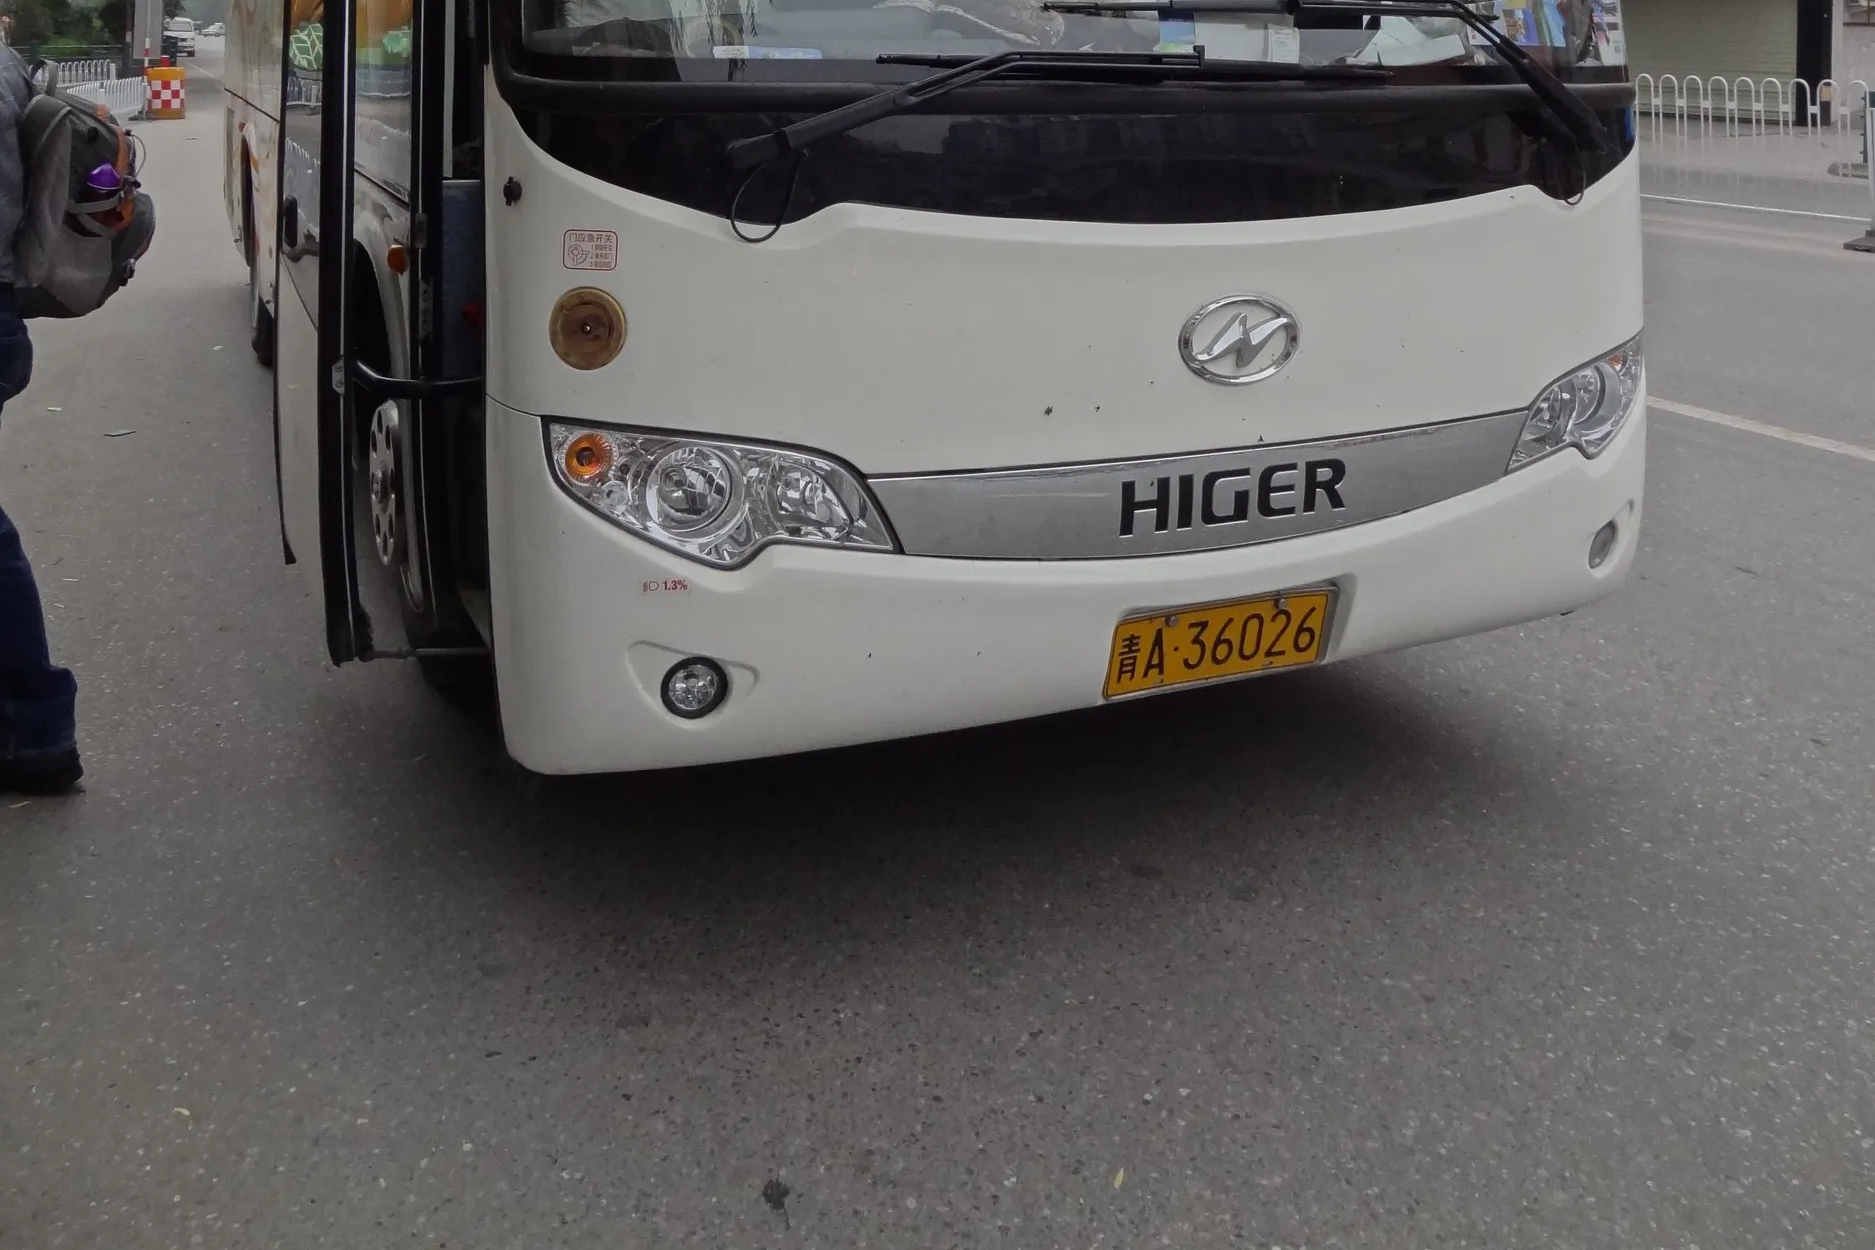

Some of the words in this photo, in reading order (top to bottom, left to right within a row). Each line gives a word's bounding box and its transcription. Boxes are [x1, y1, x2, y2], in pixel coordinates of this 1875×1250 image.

[569, 232, 613, 244] 门应急开关
[1119, 458, 1347, 538] HIGER
[661, 579, 688, 591] 1.3%
